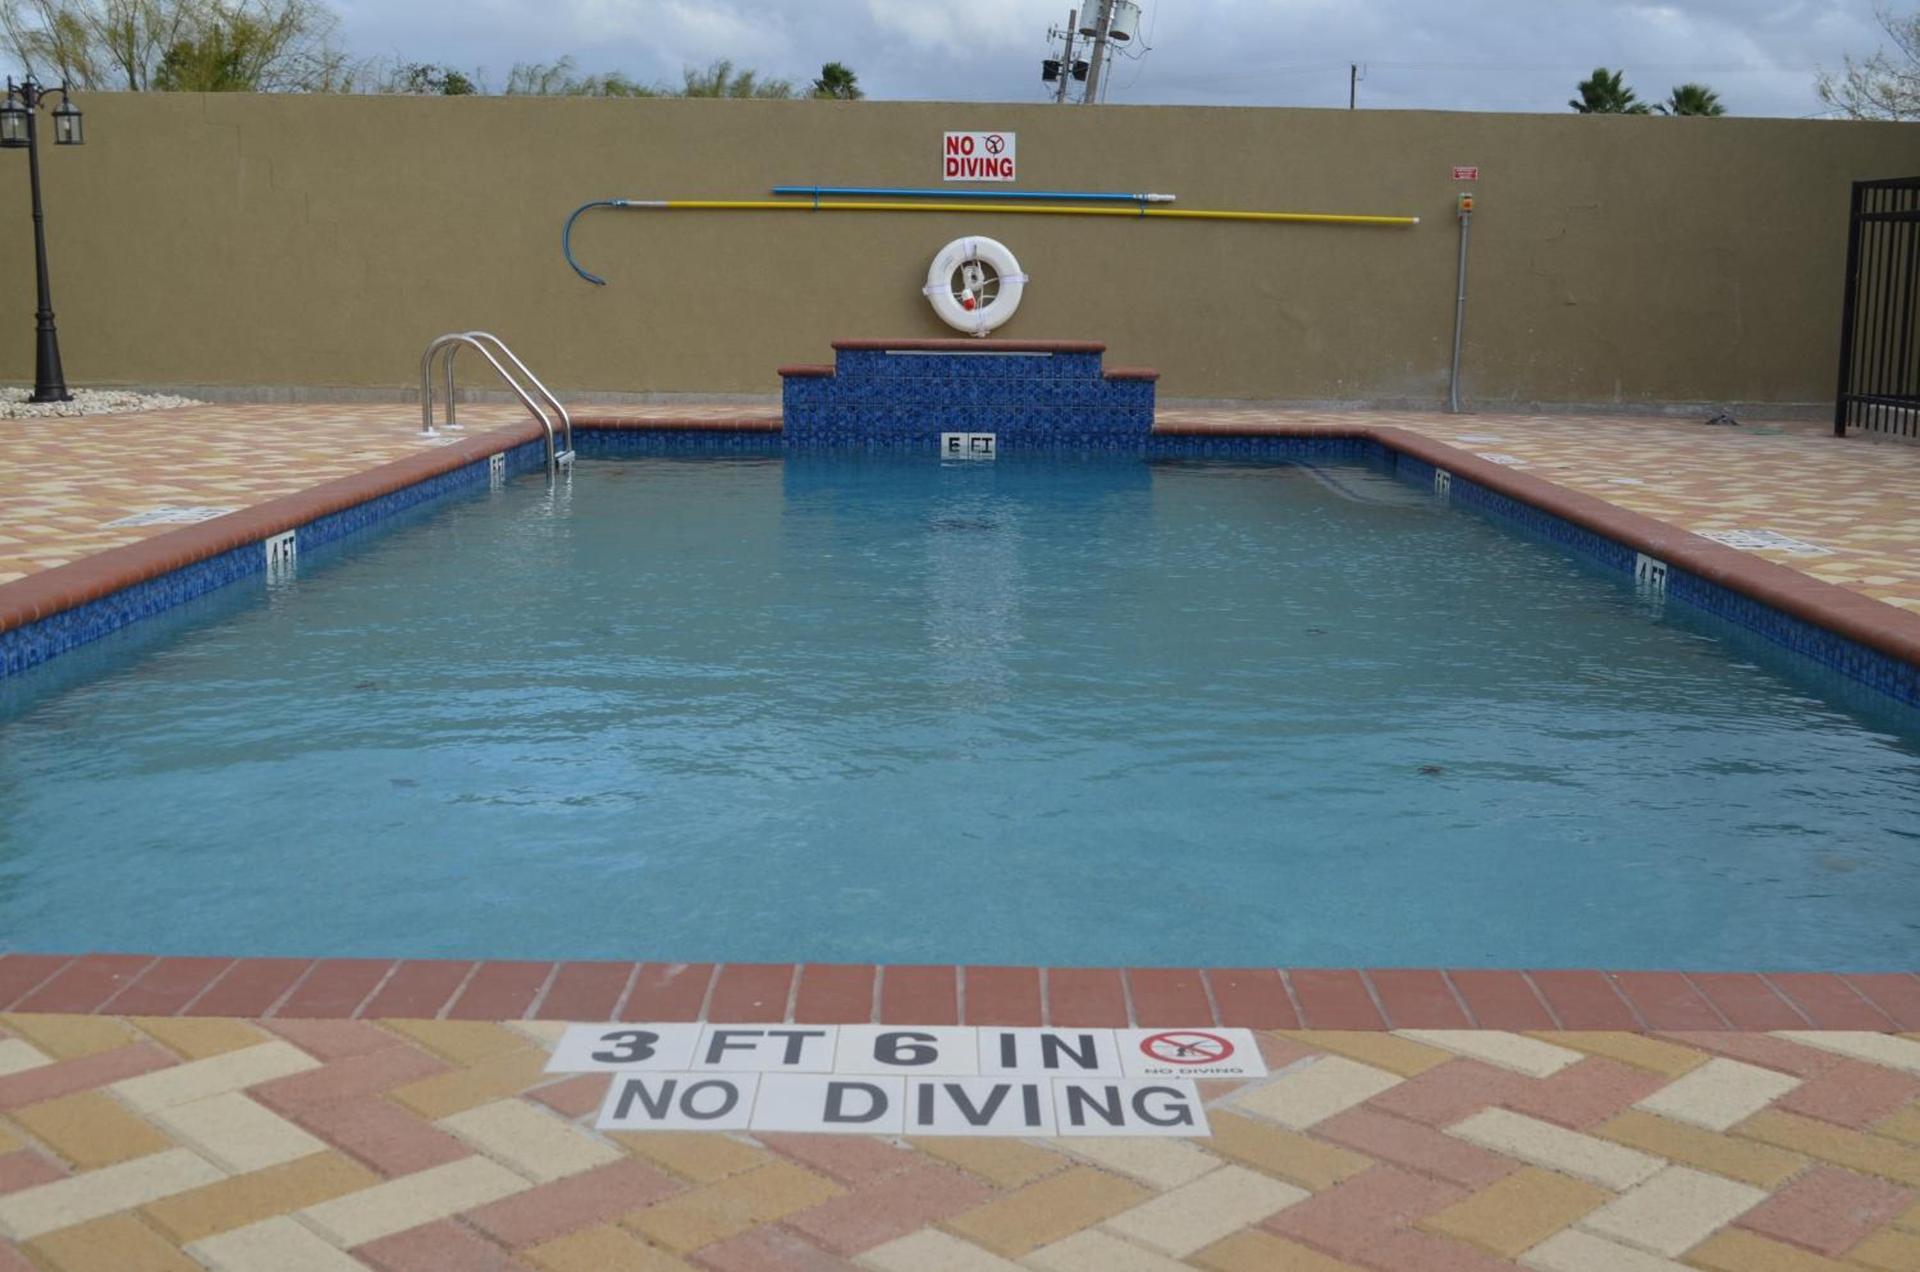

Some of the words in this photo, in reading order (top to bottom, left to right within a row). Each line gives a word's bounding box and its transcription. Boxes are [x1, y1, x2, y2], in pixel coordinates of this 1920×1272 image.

[946, 135, 974, 156] NO
[946, 157, 1013, 177] DIVING
[591, 1030, 660, 1063] 3
[705, 1030, 826, 1065] FT
[873, 1032, 939, 1066] 6
[1000, 1033, 1099, 1070] IN
[612, 1079, 740, 1120] NO
[822, 1081, 1195, 1127] DIVING
